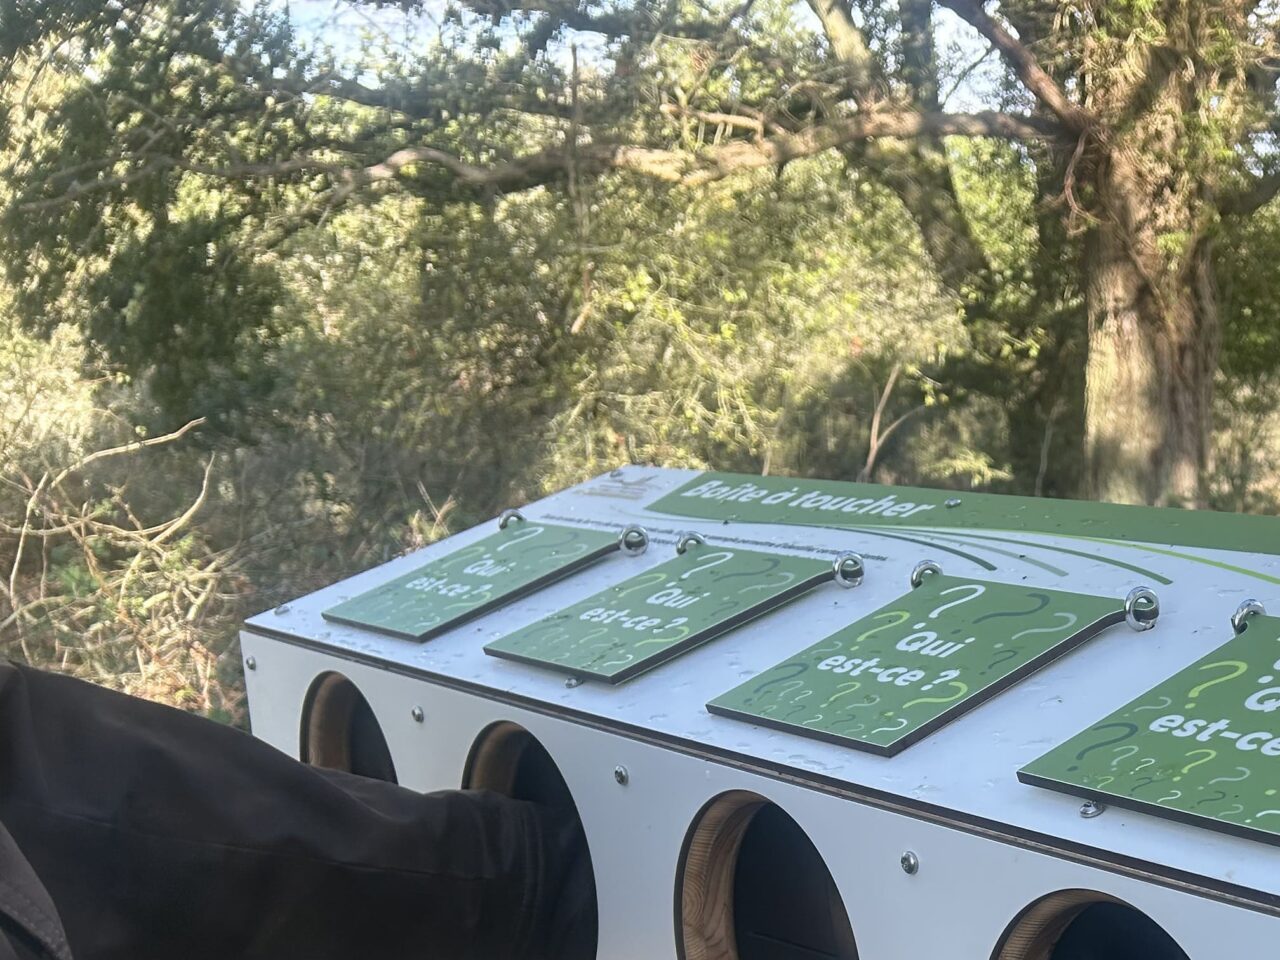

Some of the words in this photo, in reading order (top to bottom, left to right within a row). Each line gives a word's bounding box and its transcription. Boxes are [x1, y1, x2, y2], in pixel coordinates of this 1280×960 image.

[680, 480, 768, 502] Boîte
[760, 487, 798, 505] à
[788, 491, 936, 517] toucher
[463, 559, 516, 577] Qui
[405, 577, 471, 597] est-ce
[646, 588, 711, 608] Qui
[580, 607, 661, 630] est-ce
[653, 617, 688, 633] ?
[896, 631, 976, 658] Qui
[816, 655, 926, 686] est-ce
[921, 669, 961, 691] ?
